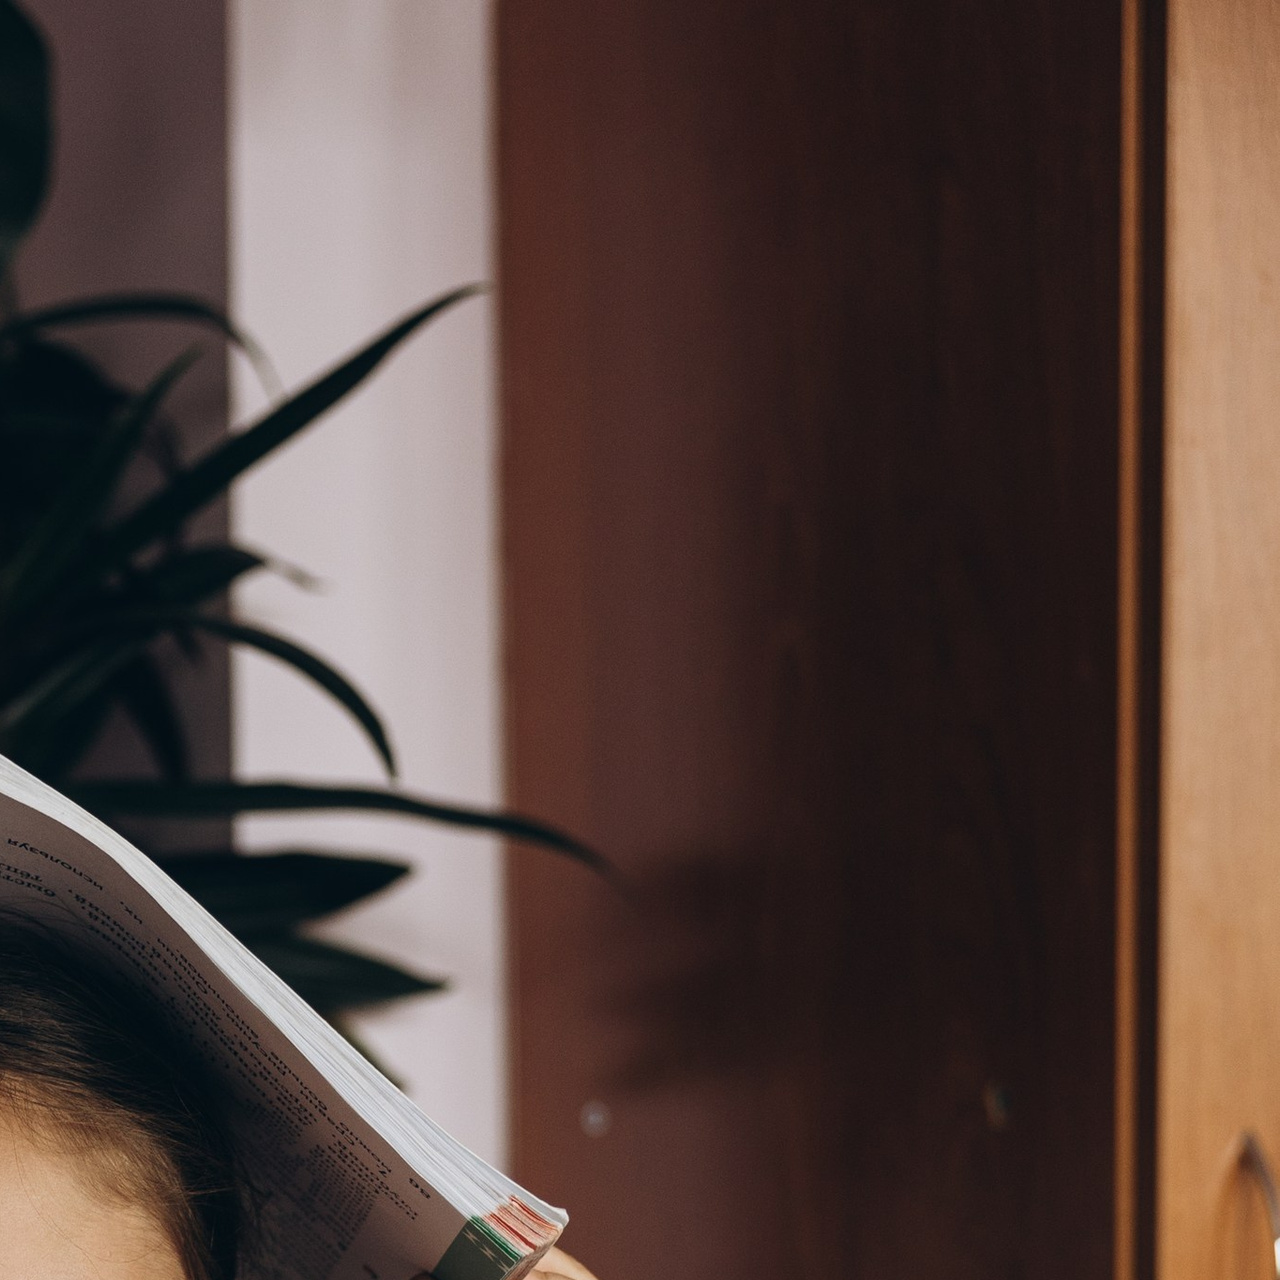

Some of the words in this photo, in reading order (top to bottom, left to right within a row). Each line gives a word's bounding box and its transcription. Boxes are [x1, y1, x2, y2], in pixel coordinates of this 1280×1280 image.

[6, 836, 104, 892] используя
[156, 938, 208, 995] Опиши
[175, 949, 259, 1039] антонимов.
[221, 1008, 286, 1076] рисунки.
[269, 1051, 327, 1111] больше
[298, 1089, 354, 1146] Сравни
[339, 1121, 392, 1174] можно
